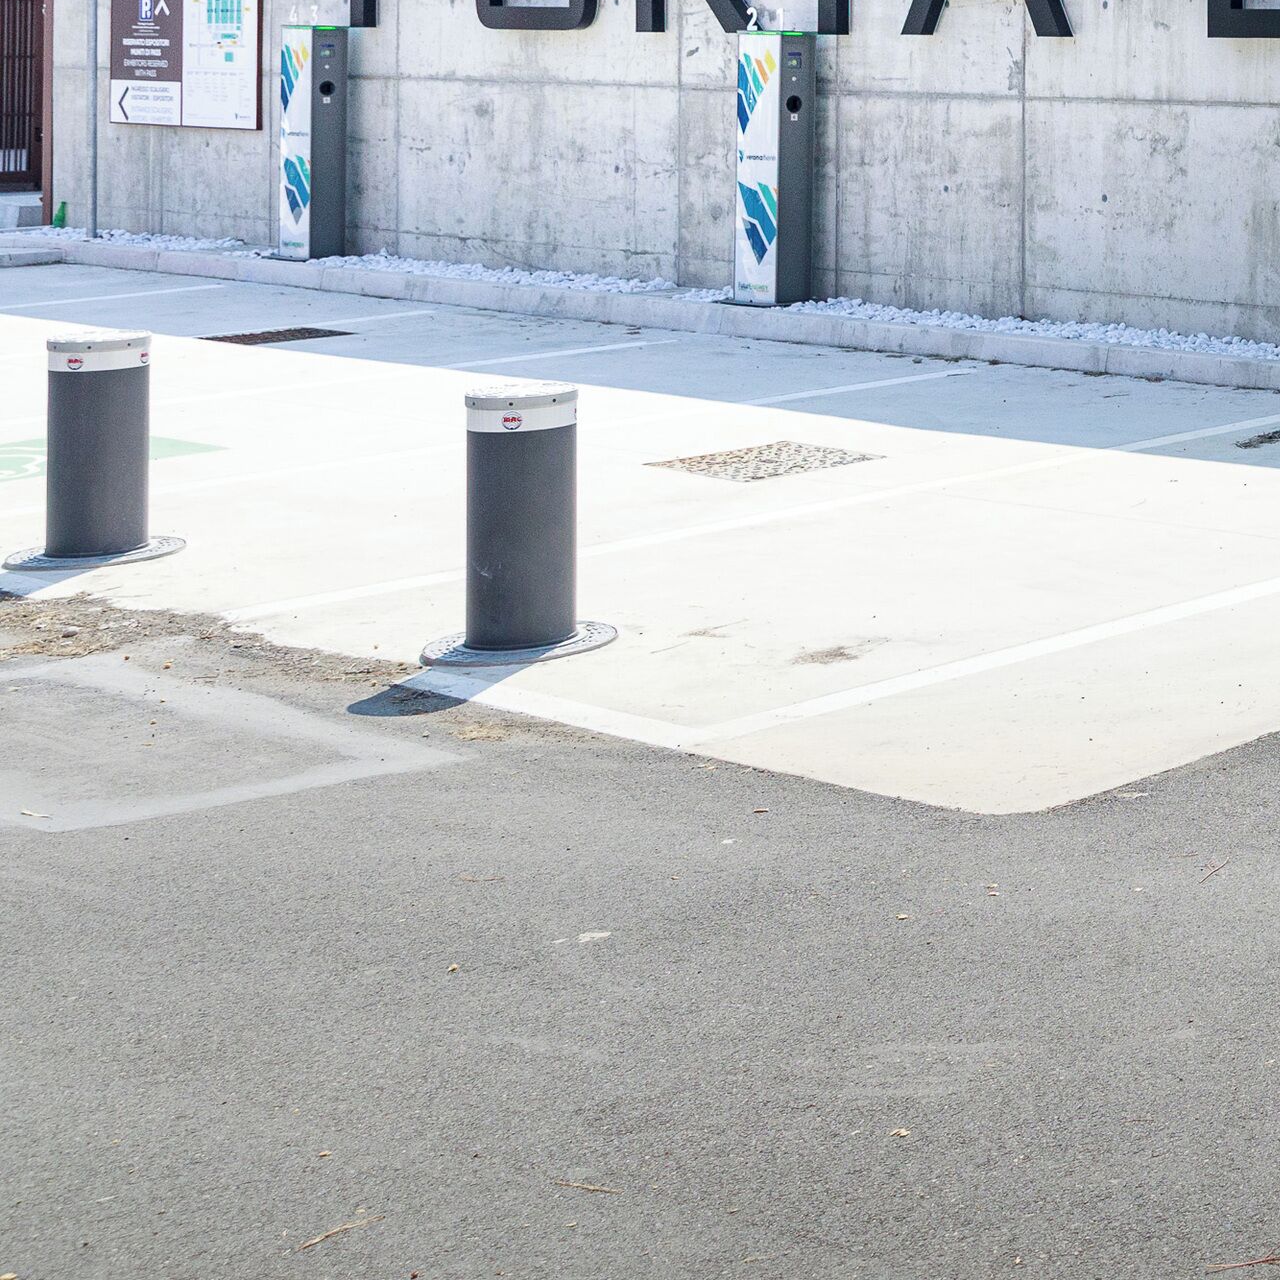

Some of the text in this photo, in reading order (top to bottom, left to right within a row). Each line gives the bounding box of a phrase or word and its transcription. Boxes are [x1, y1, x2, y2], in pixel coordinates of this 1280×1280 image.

[288, 5, 298, 21] 4
[310, 5, 318, 23] 3
[746, 7, 758, 30] 2
[775, 7, 784, 31] 1
